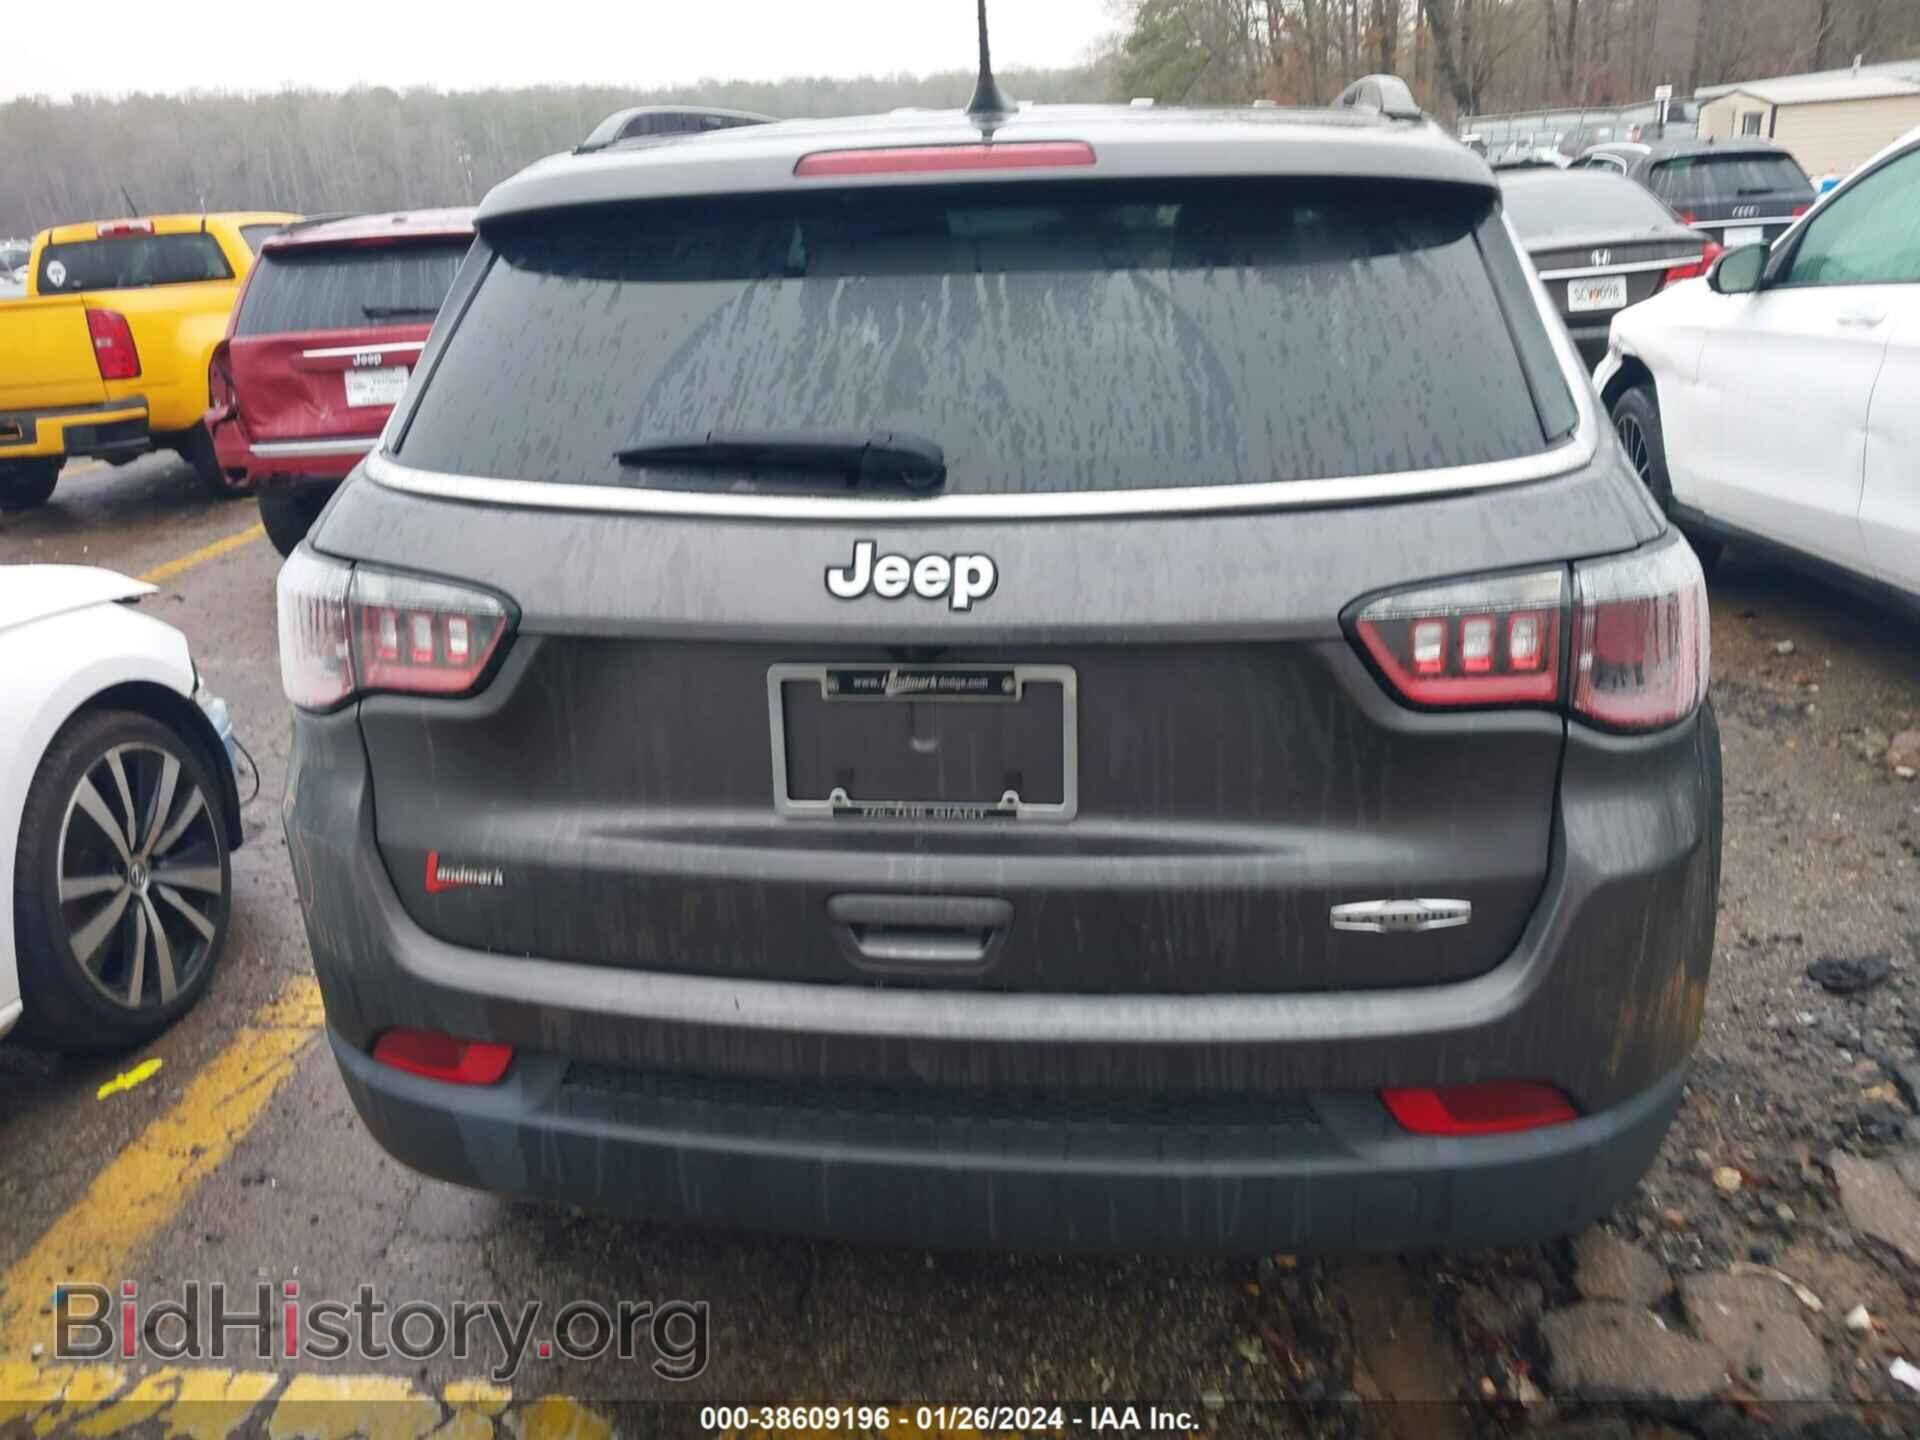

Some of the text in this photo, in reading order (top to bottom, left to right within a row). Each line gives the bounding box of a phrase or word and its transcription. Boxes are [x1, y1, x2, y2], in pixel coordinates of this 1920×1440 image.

[352, 352, 383, 367] Jeep
[825, 539, 998, 612] Jeep
[425, 849, 504, 894] Landmark
